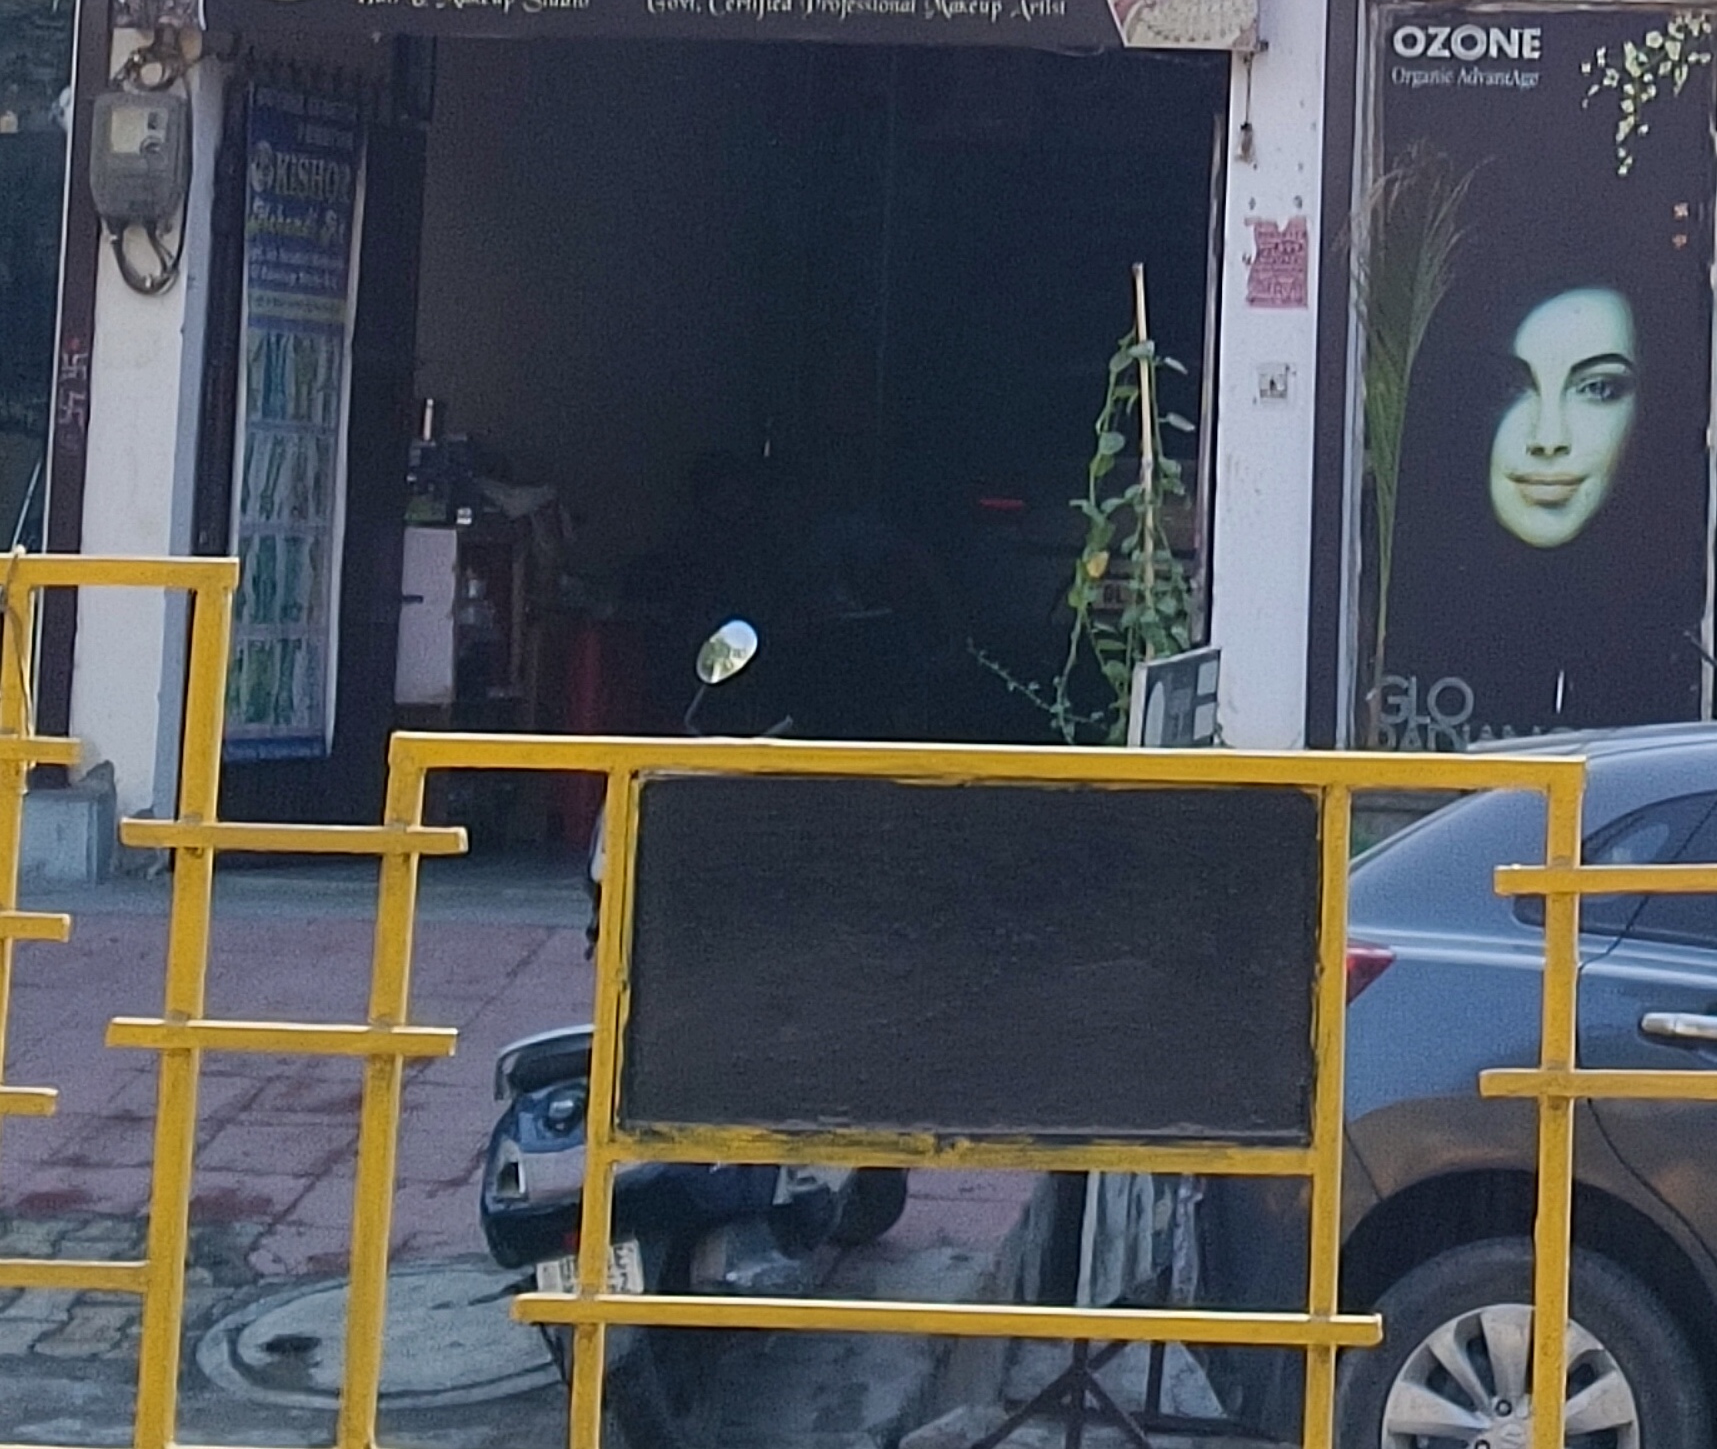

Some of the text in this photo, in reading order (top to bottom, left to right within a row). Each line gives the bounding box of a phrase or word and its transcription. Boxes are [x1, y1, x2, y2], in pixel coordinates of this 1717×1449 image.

[1391, 24, 1542, 62] OZONE
[1391, 64, 1454, 90] Organic
[1377, 674, 1475, 727] GLO
